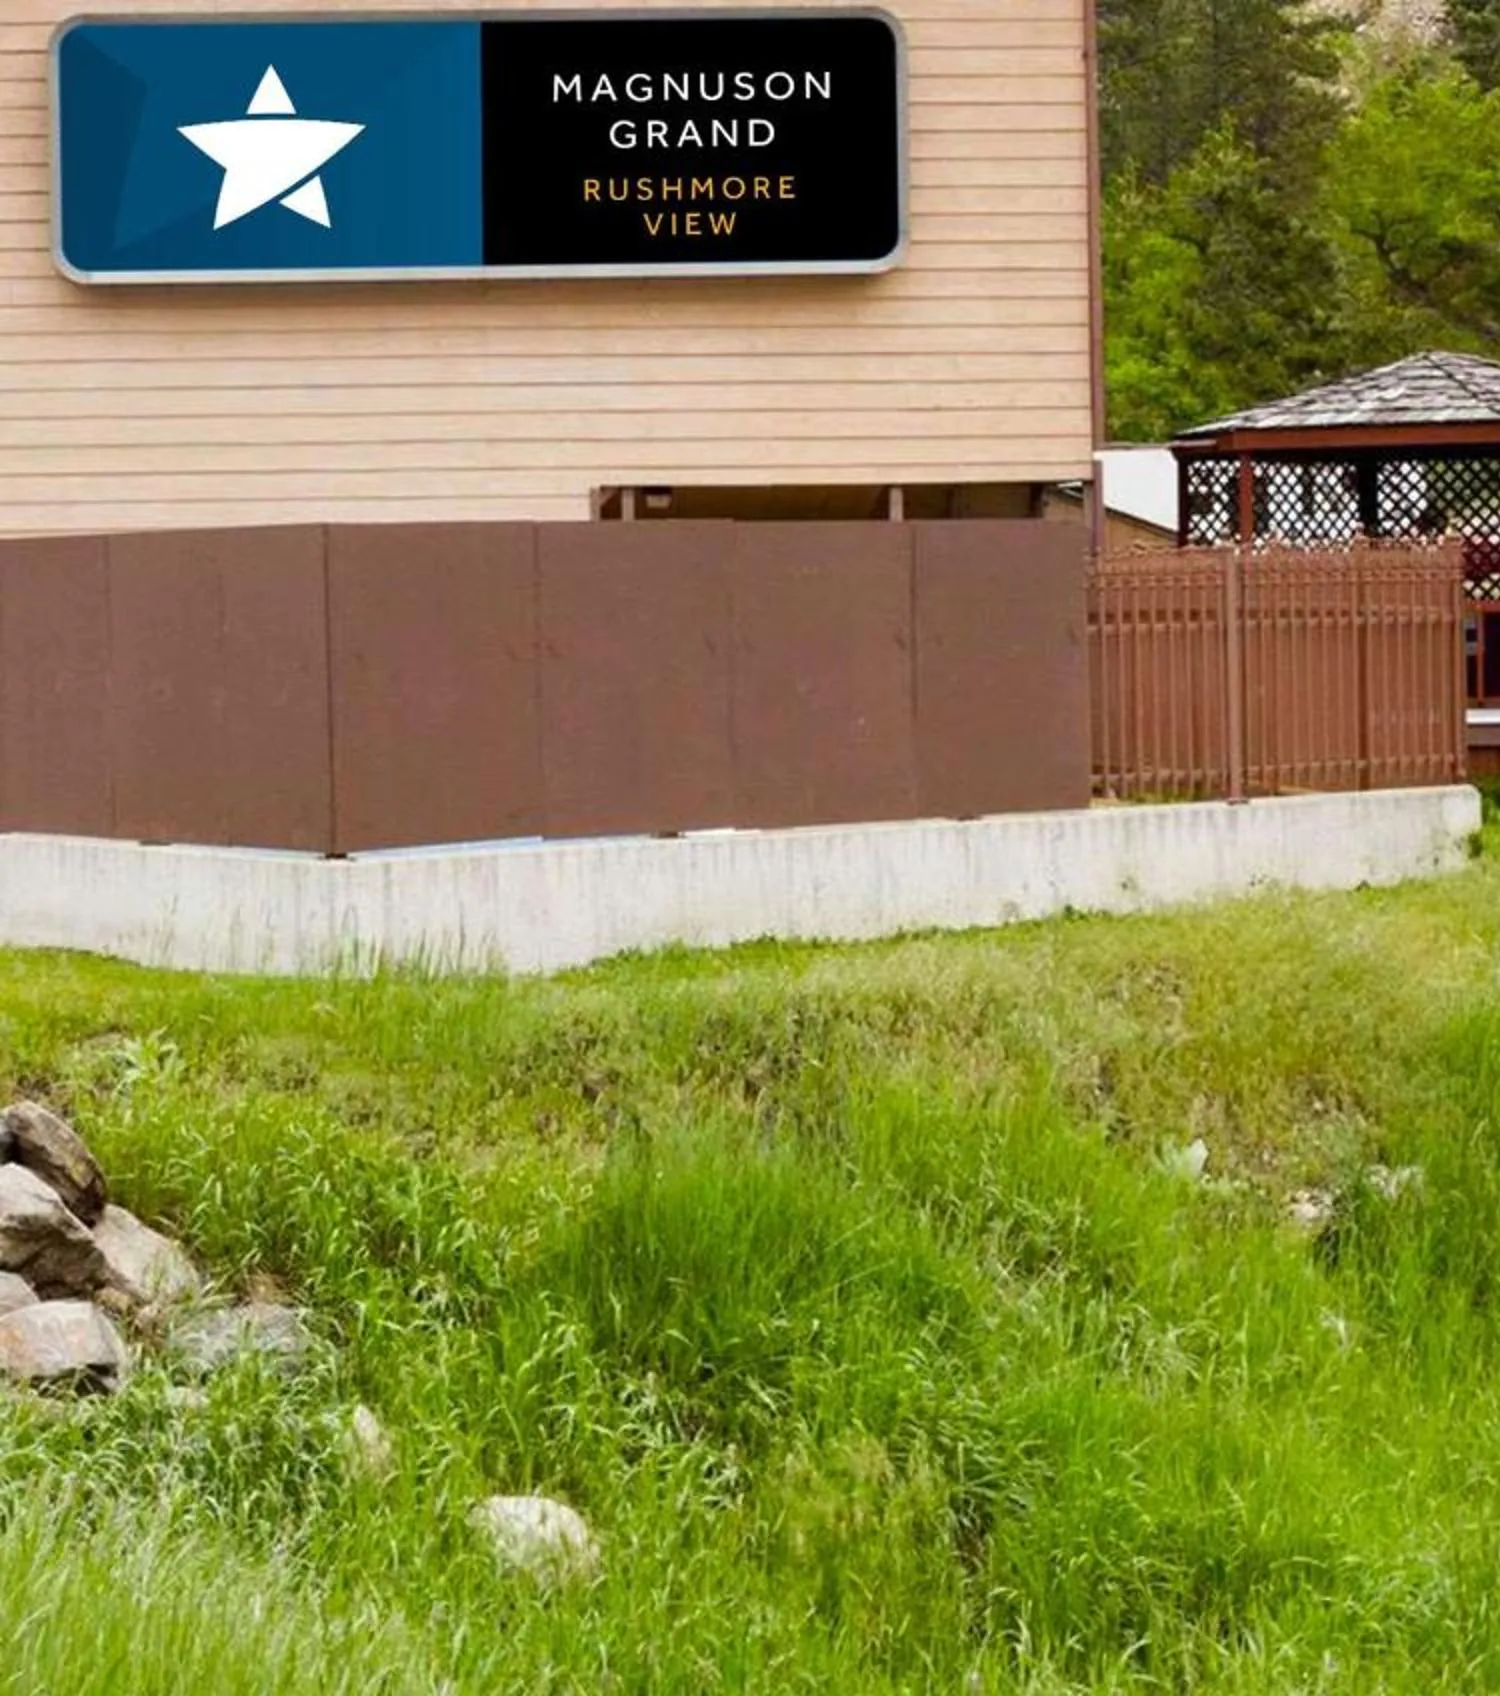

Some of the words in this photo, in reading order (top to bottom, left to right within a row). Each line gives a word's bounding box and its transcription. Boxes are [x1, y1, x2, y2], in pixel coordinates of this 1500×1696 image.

[552, 71, 832, 103] MAGNUSON
[609, 118, 776, 149] GRAND
[584, 175, 796, 202] RUSHMORE
[643, 212, 737, 236] VIEW
